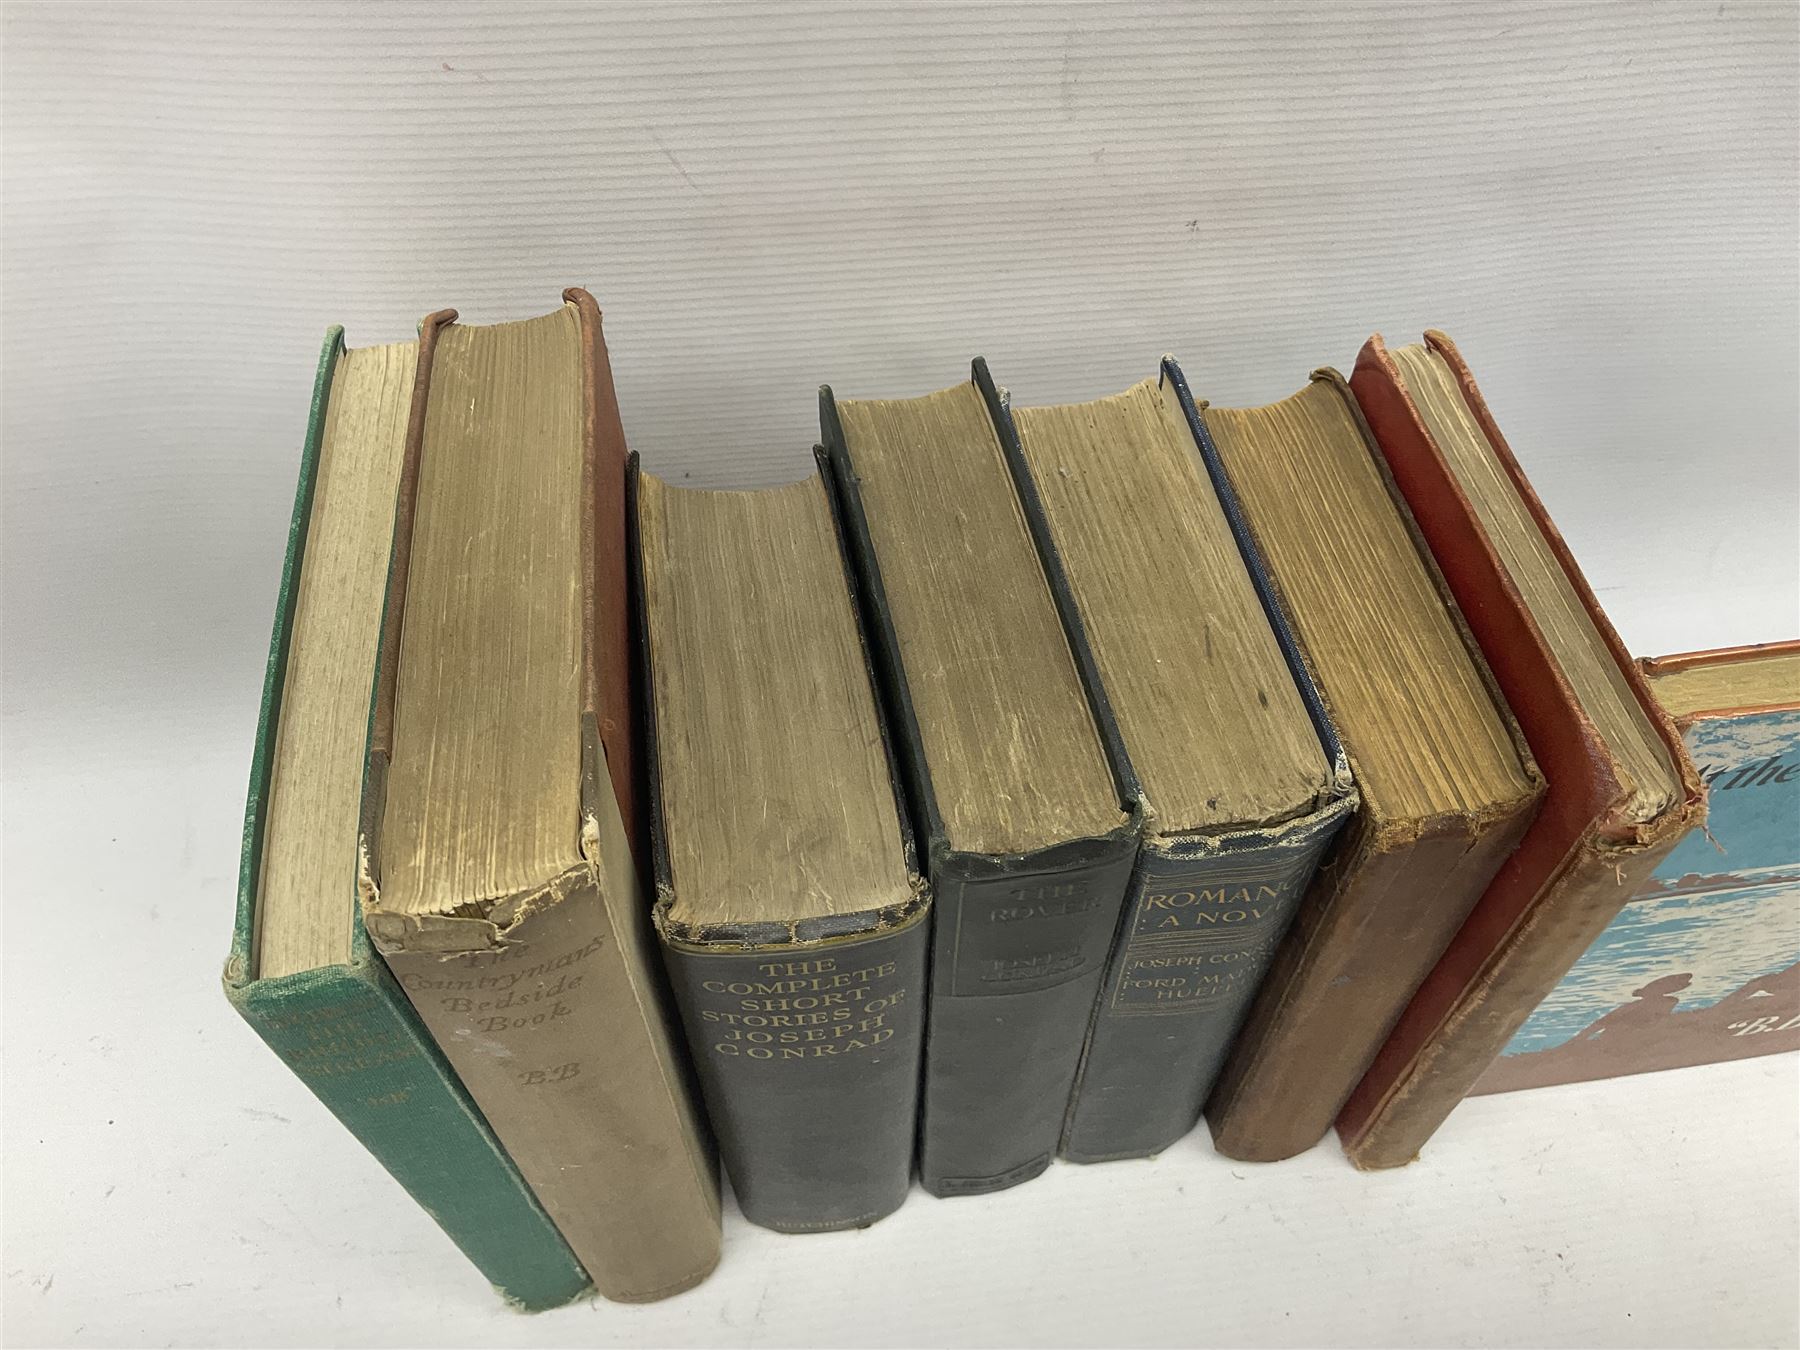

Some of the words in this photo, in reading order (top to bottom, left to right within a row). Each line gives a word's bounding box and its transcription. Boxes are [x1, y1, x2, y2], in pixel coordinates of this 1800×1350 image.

[1722, 755, 1800, 790] the
[1158, 914, 1180, 929] A
[702, 961, 898, 996] COMPLETE
[759, 957, 837, 977] THE
[1128, 956, 1203, 971] JOSEPH
[441, 974, 583, 1014] Bedside
[740, 986, 871, 1012] SHORT
[1122, 977, 1187, 991] FORD
[477, 1002, 573, 1034] Book
[702, 1007, 852, 1028] STORIES
[864, 988, 907, 1014] OF
[714, 1028, 896, 1060] CONRAD
[724, 1013, 886, 1044] JOSEPH
